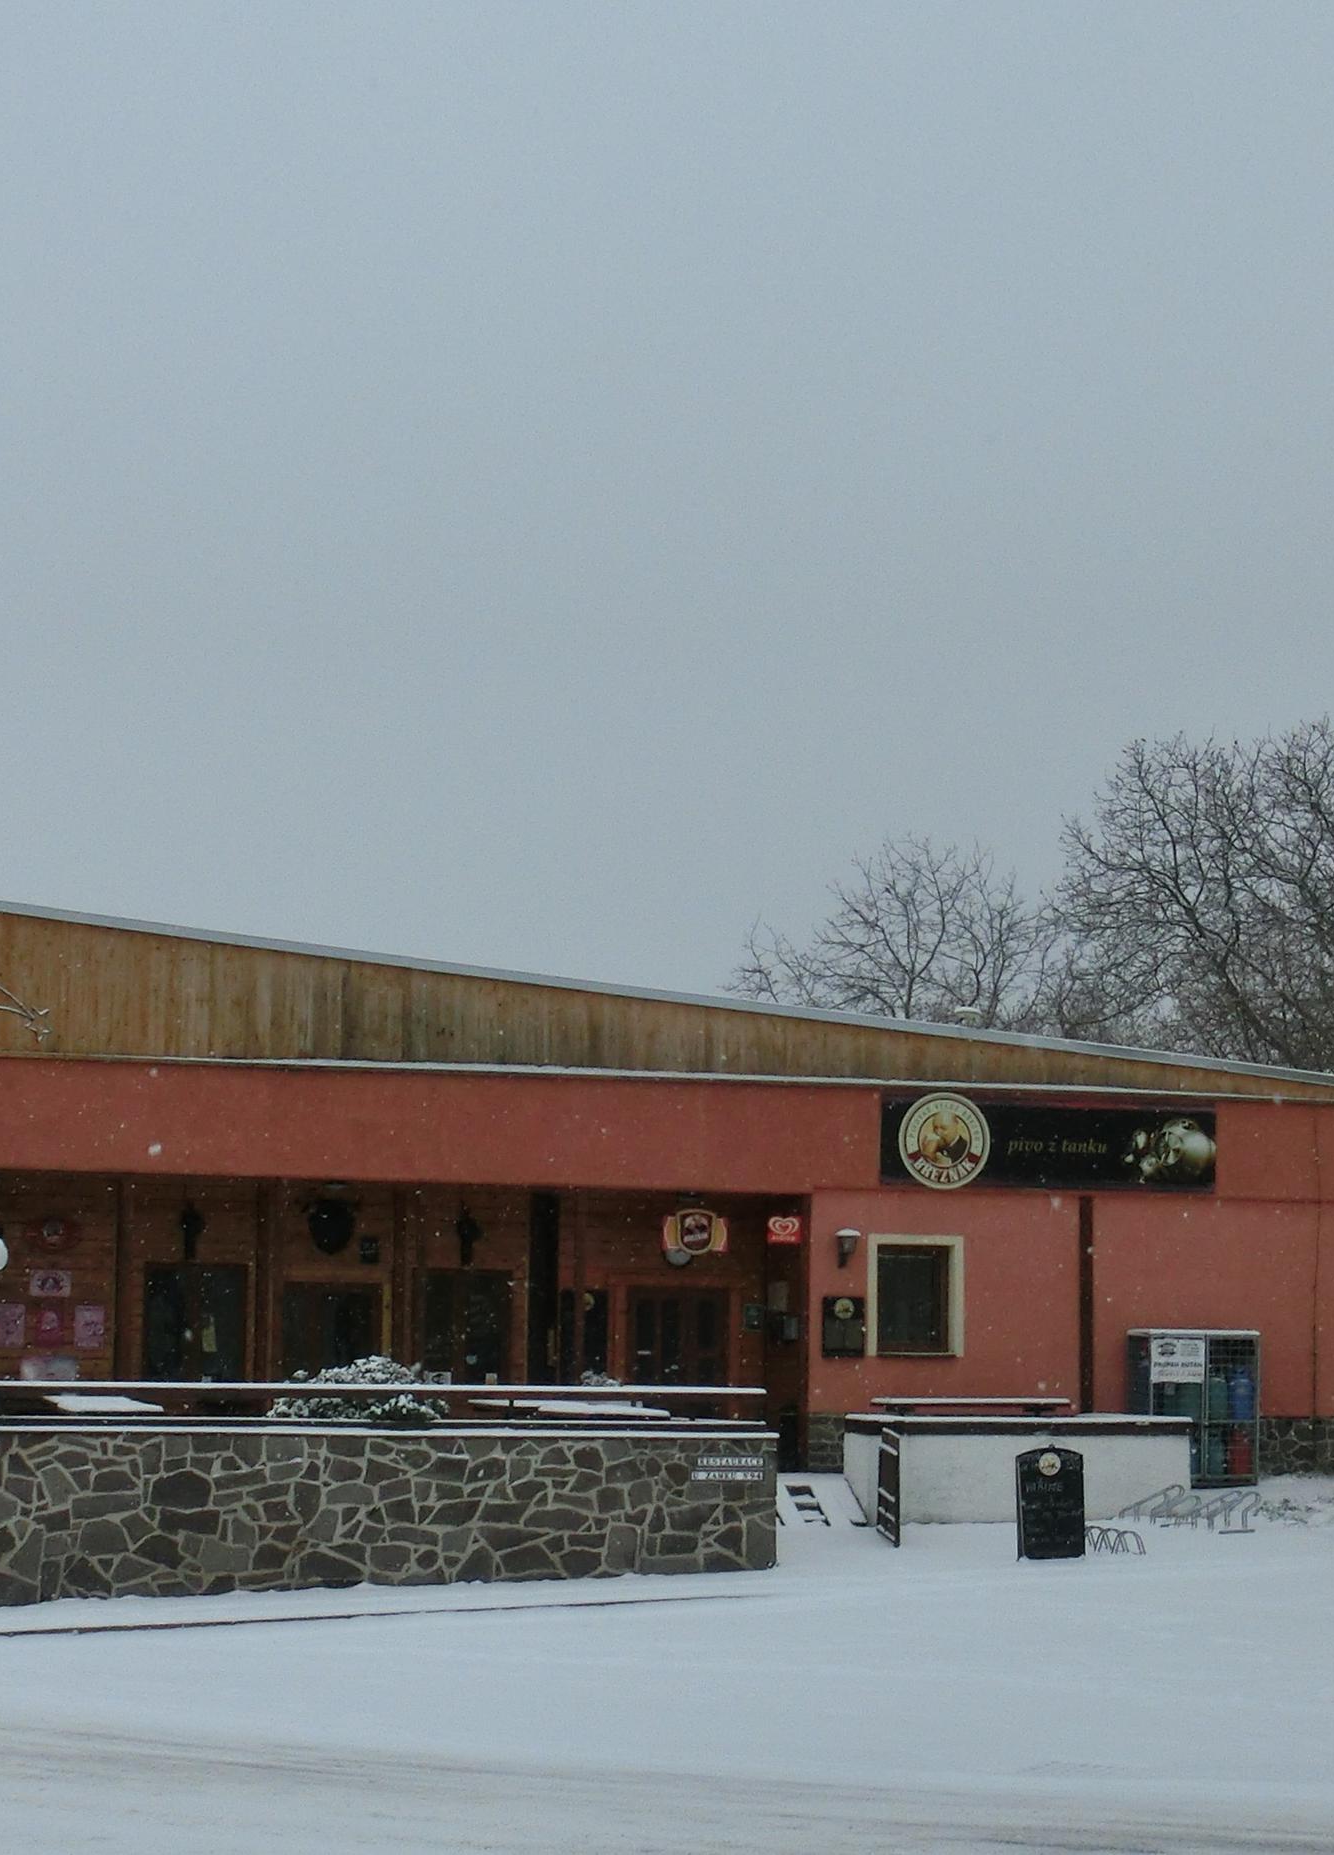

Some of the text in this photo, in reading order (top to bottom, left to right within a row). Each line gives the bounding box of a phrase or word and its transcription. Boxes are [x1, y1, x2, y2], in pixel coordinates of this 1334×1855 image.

[1007, 1138, 1107, 1155] pivo z tanku
